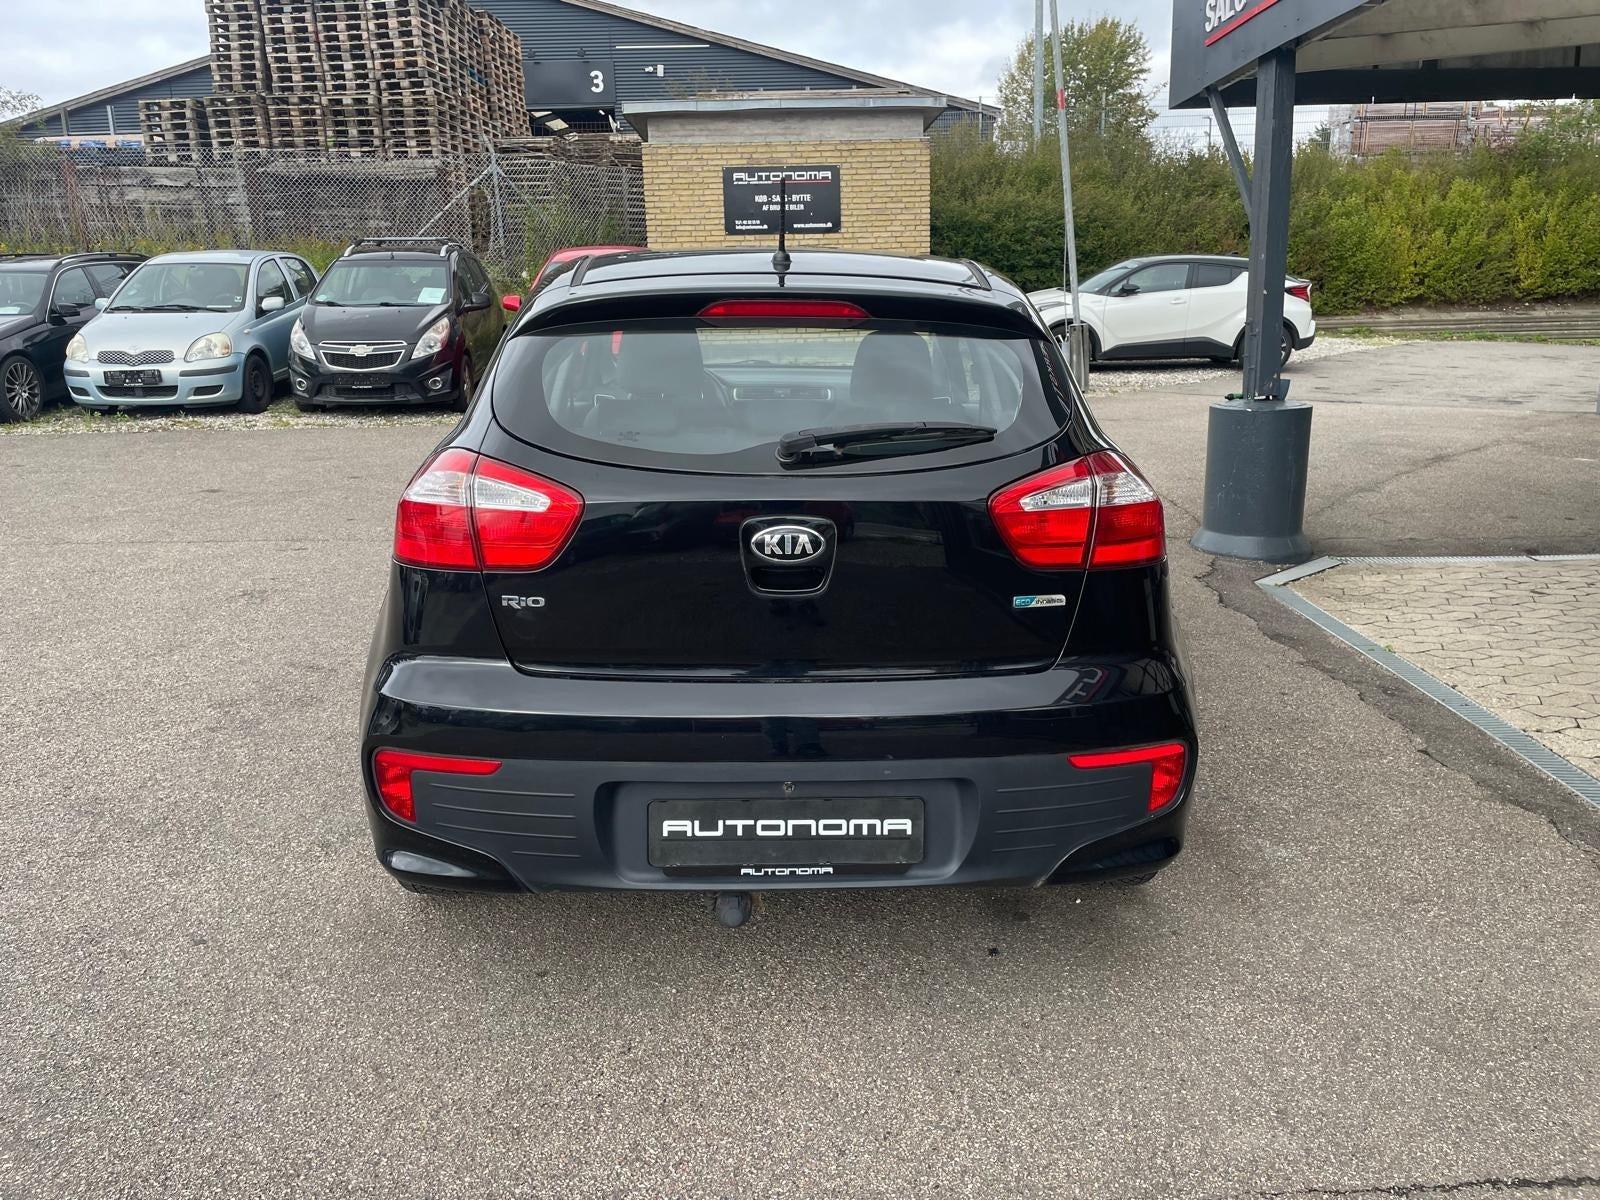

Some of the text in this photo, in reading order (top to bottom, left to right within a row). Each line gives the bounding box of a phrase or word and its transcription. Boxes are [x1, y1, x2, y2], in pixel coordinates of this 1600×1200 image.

[590, 70, 604, 93] 3
[733, 171, 832, 181] AUTONOMA
[755, 195, 768, 203] KØB
[772, 194, 788, 202] SAG
[792, 194, 812, 202] BYTTE
[764, 534, 813, 555] KIA
[662, 818, 912, 837] AUTONOMA
[740, 867, 834, 876] AUTONOMA
